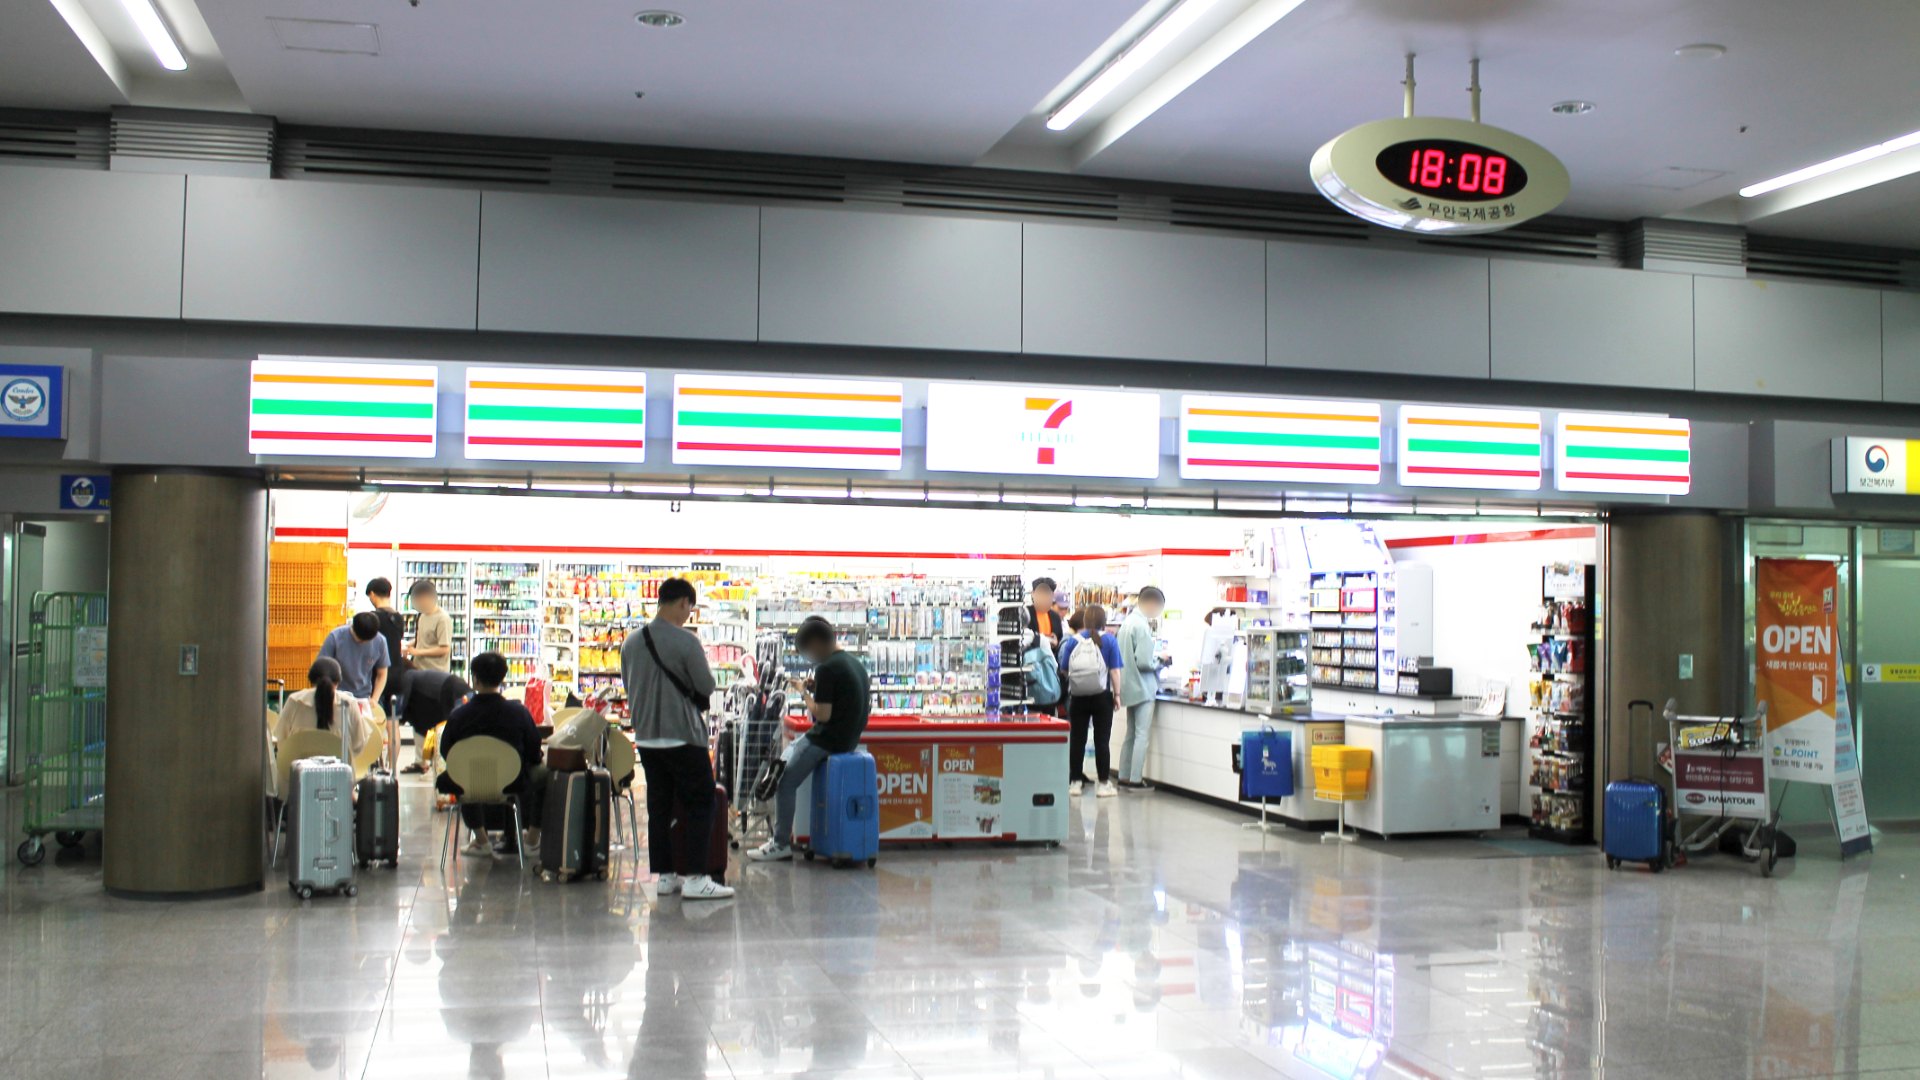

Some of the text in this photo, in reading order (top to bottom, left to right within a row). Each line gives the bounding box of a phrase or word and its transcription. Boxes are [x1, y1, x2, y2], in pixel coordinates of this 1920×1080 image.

[1409, 149, 1507, 195] 18:08
[1427, 202, 1516, 221] 무안국제공항
[1025, 397, 1072, 465] 7
[1859, 477, 1895, 488] 보건복지부
[1763, 624, 1831, 655] OPEN
[1784, 748, 1819, 759] L.POINT
[943, 759, 975, 772] OPEN
[876, 773, 928, 795] OPEN
[1708, 795, 1756, 806] HANATOUR
